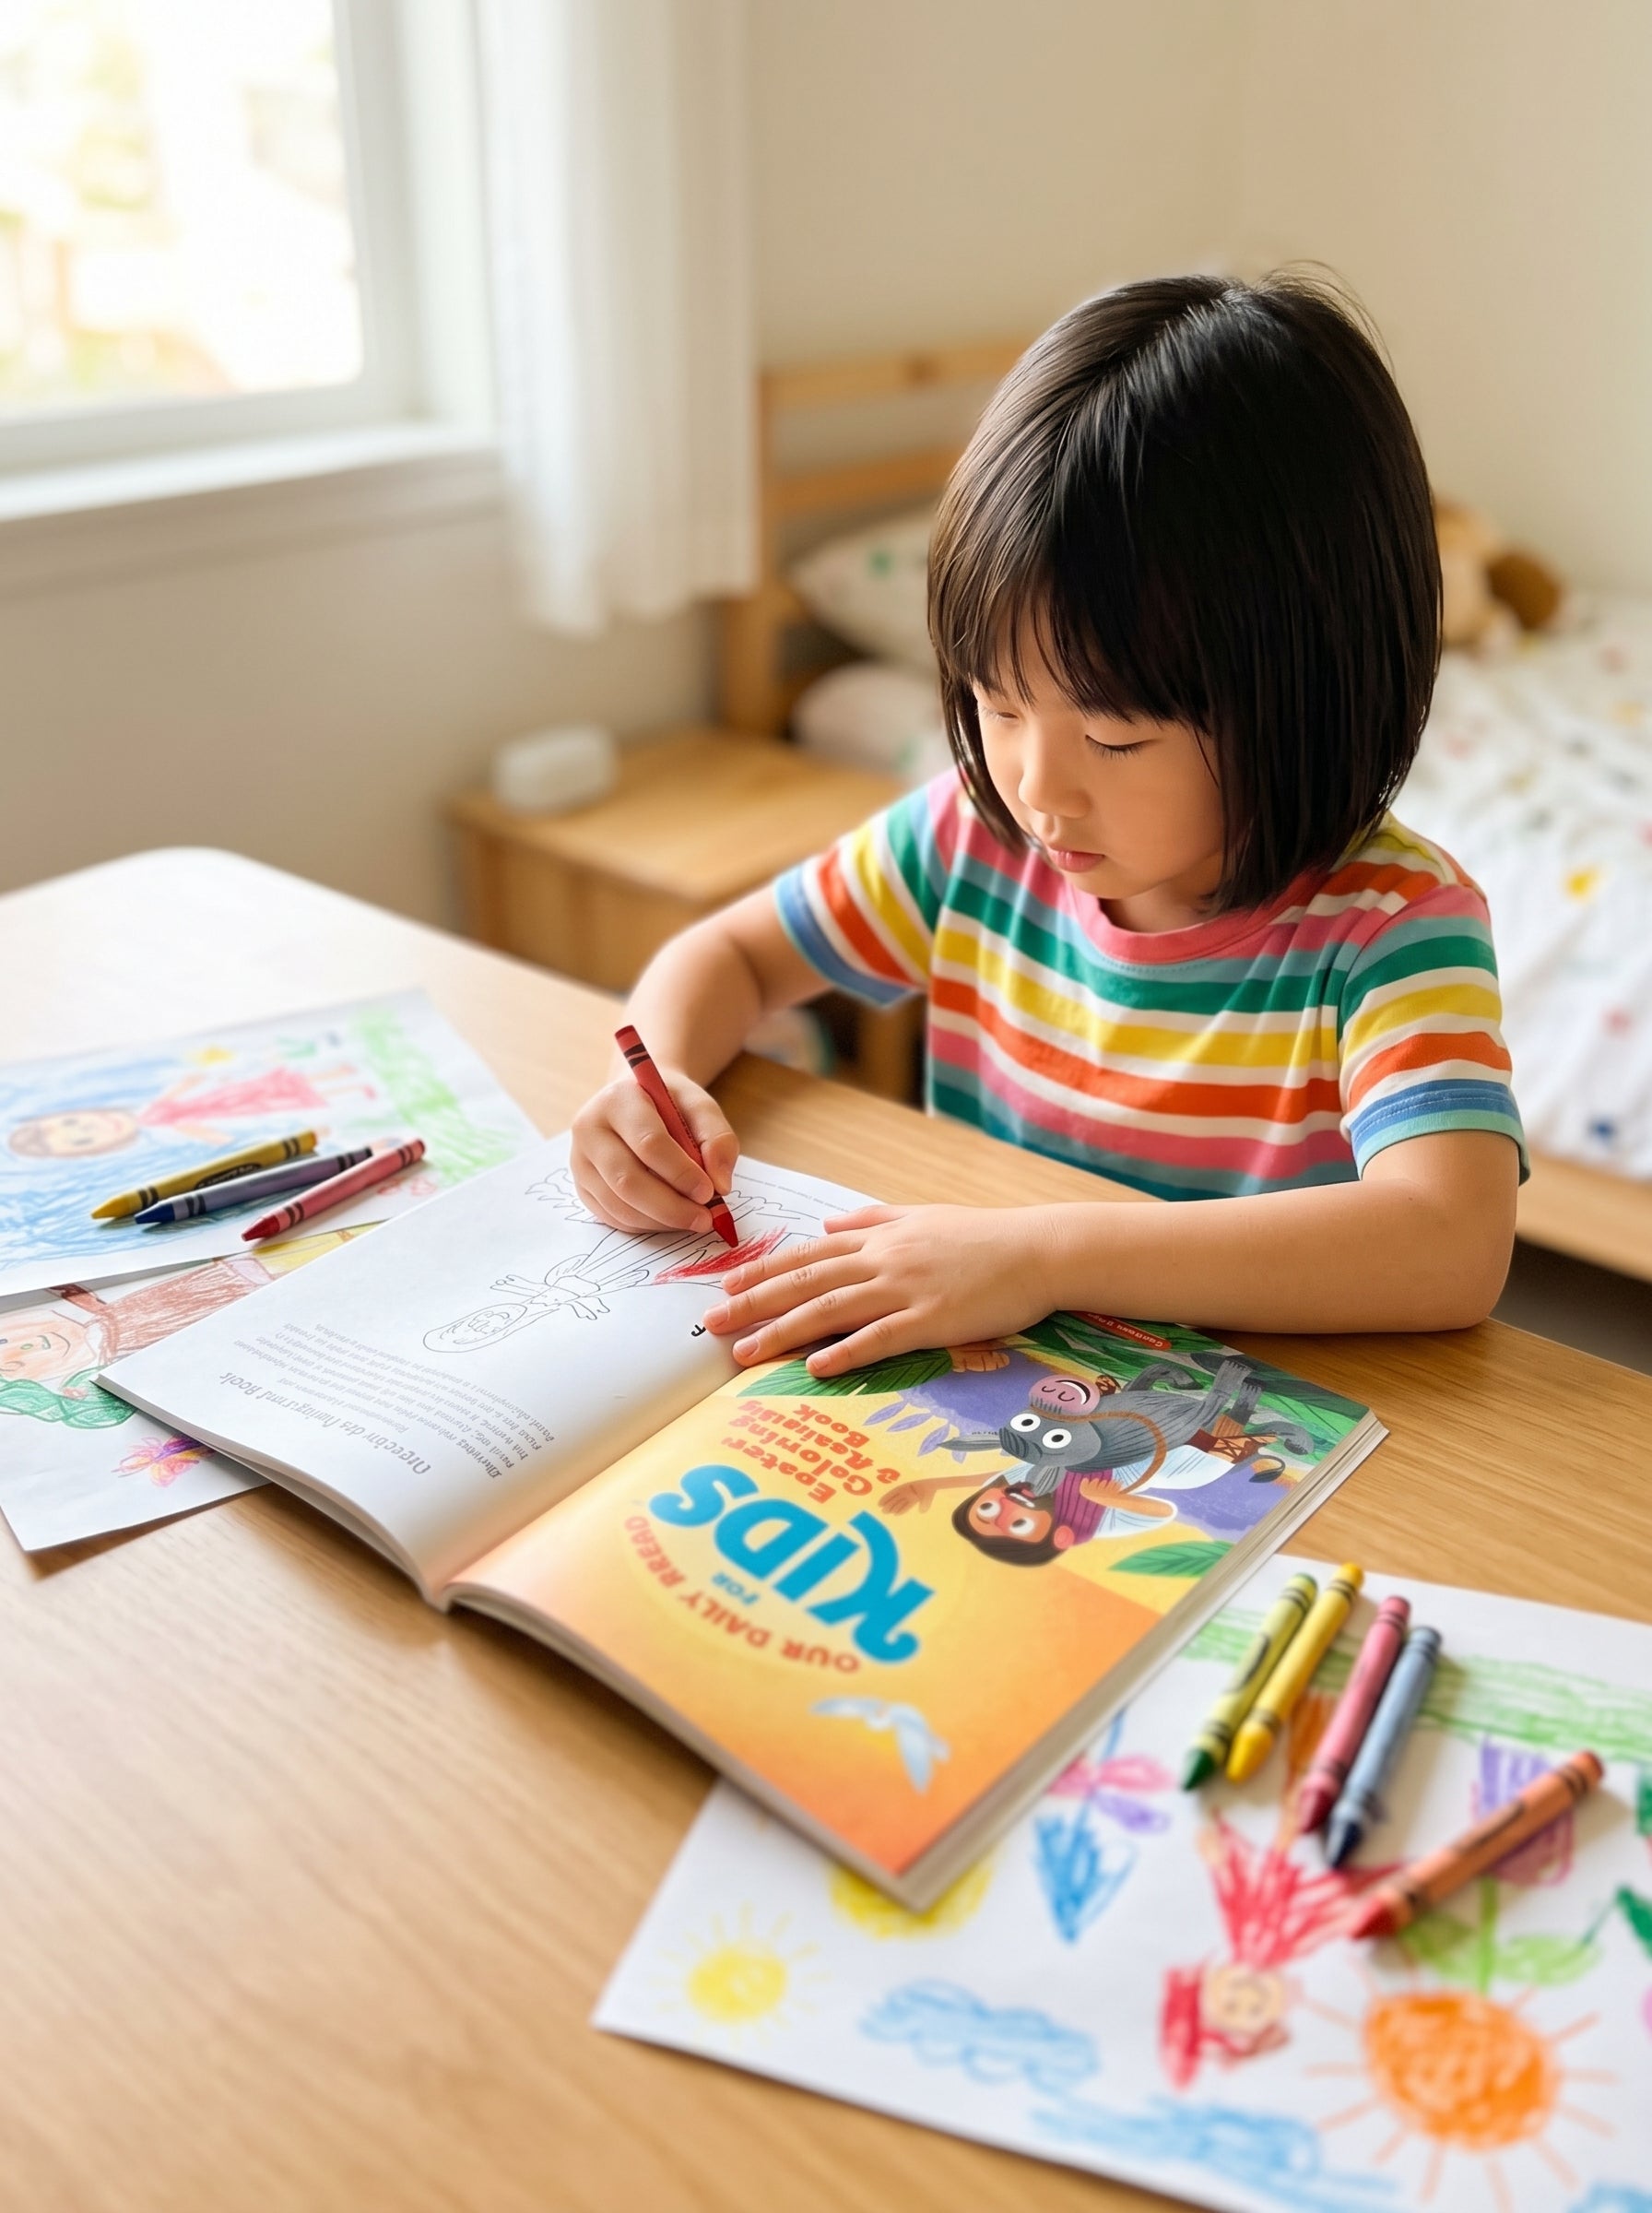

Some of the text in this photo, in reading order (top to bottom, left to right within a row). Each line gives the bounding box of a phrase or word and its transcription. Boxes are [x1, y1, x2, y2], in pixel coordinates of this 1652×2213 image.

[793, 1403, 870, 1449] Book
[648, 1464, 935, 1665] KIDS
[711, 1572, 761, 1608] FOR
[678, 1591, 773, 1649] DAILY
[780, 1638, 861, 1674] OUR
